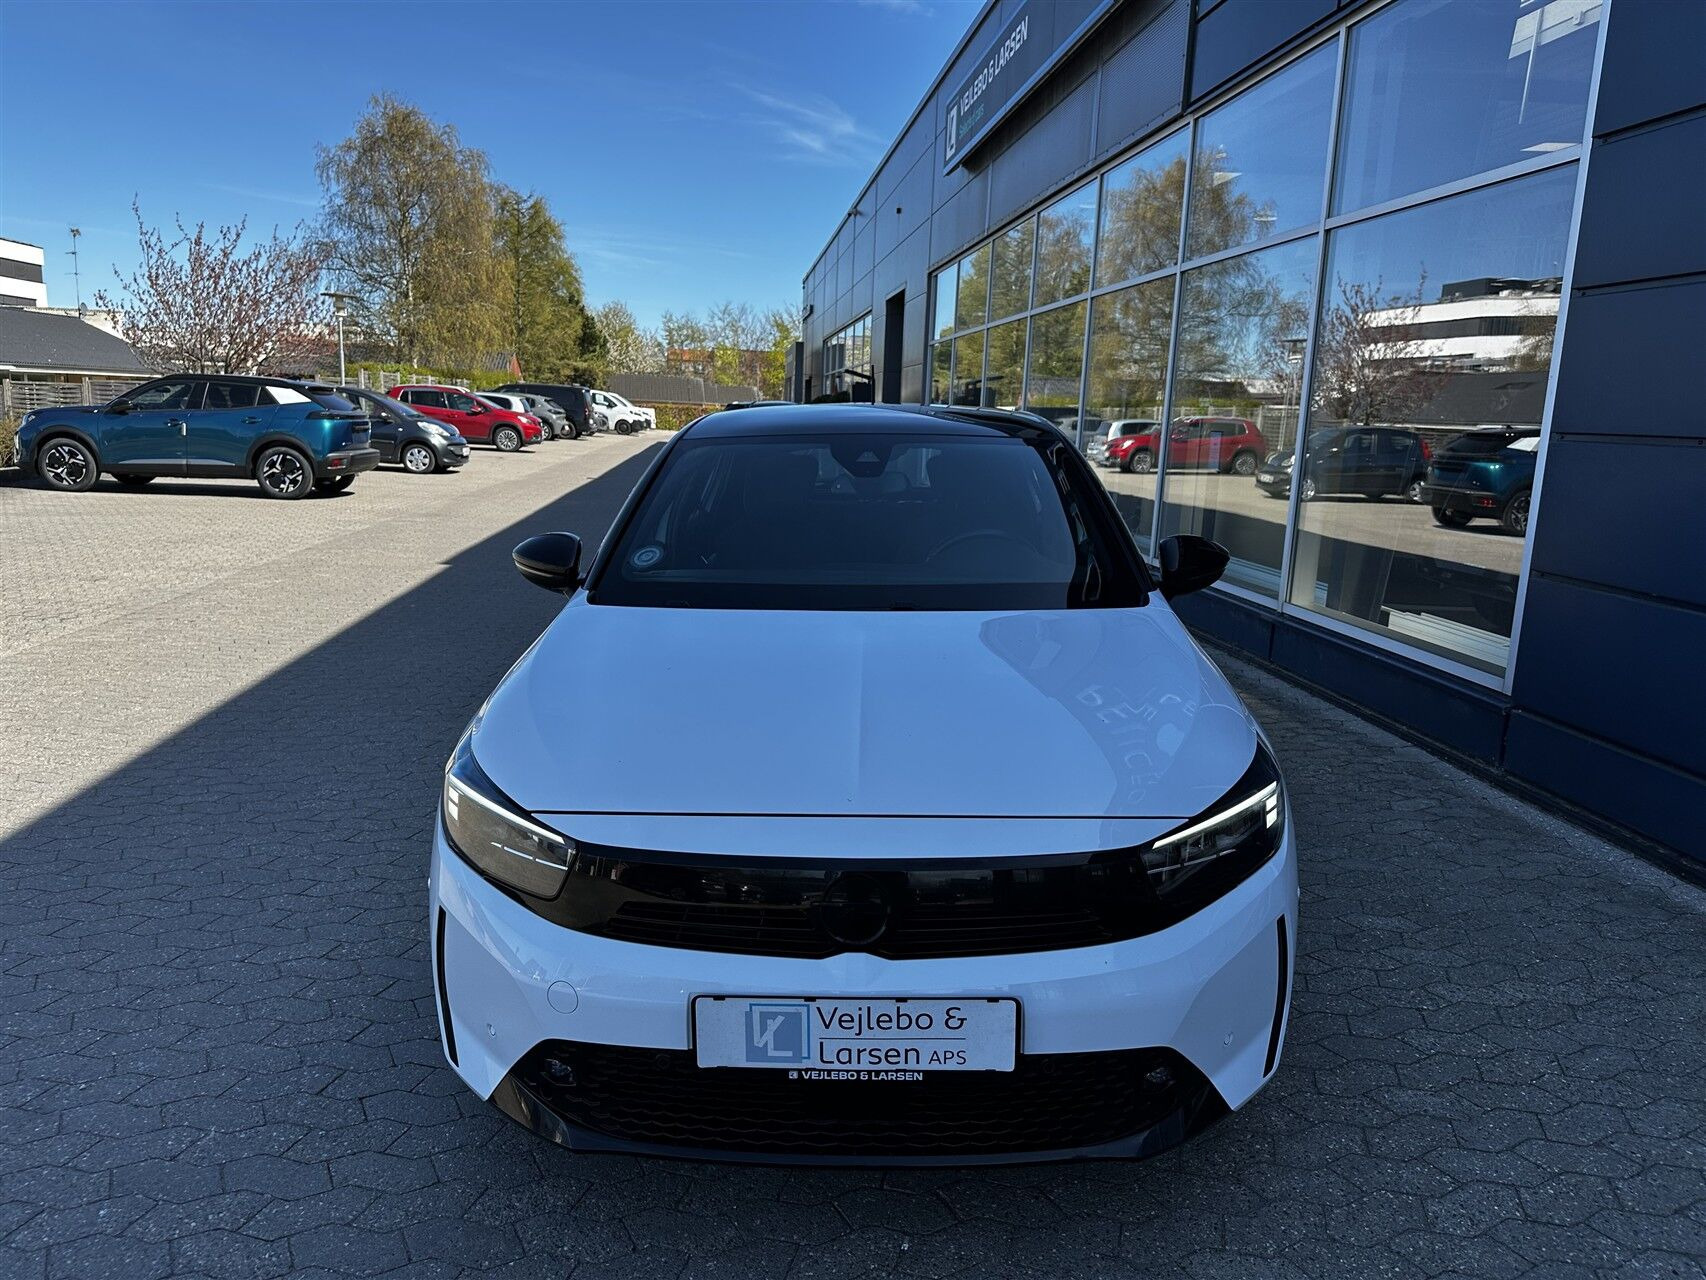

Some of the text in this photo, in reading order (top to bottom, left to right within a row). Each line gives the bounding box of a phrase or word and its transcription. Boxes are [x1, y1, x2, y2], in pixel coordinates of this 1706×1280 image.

[960, 67, 988, 116] VEJLEBO
[988, 60, 994, 83] &
[994, 15, 1029, 75] LARSEN
[815, 1006, 968, 1036] Vejlebo &
[819, 1041, 967, 1066] Larsen APS
[802, 1071, 923, 1081] VEJLEBO & LARSEN
